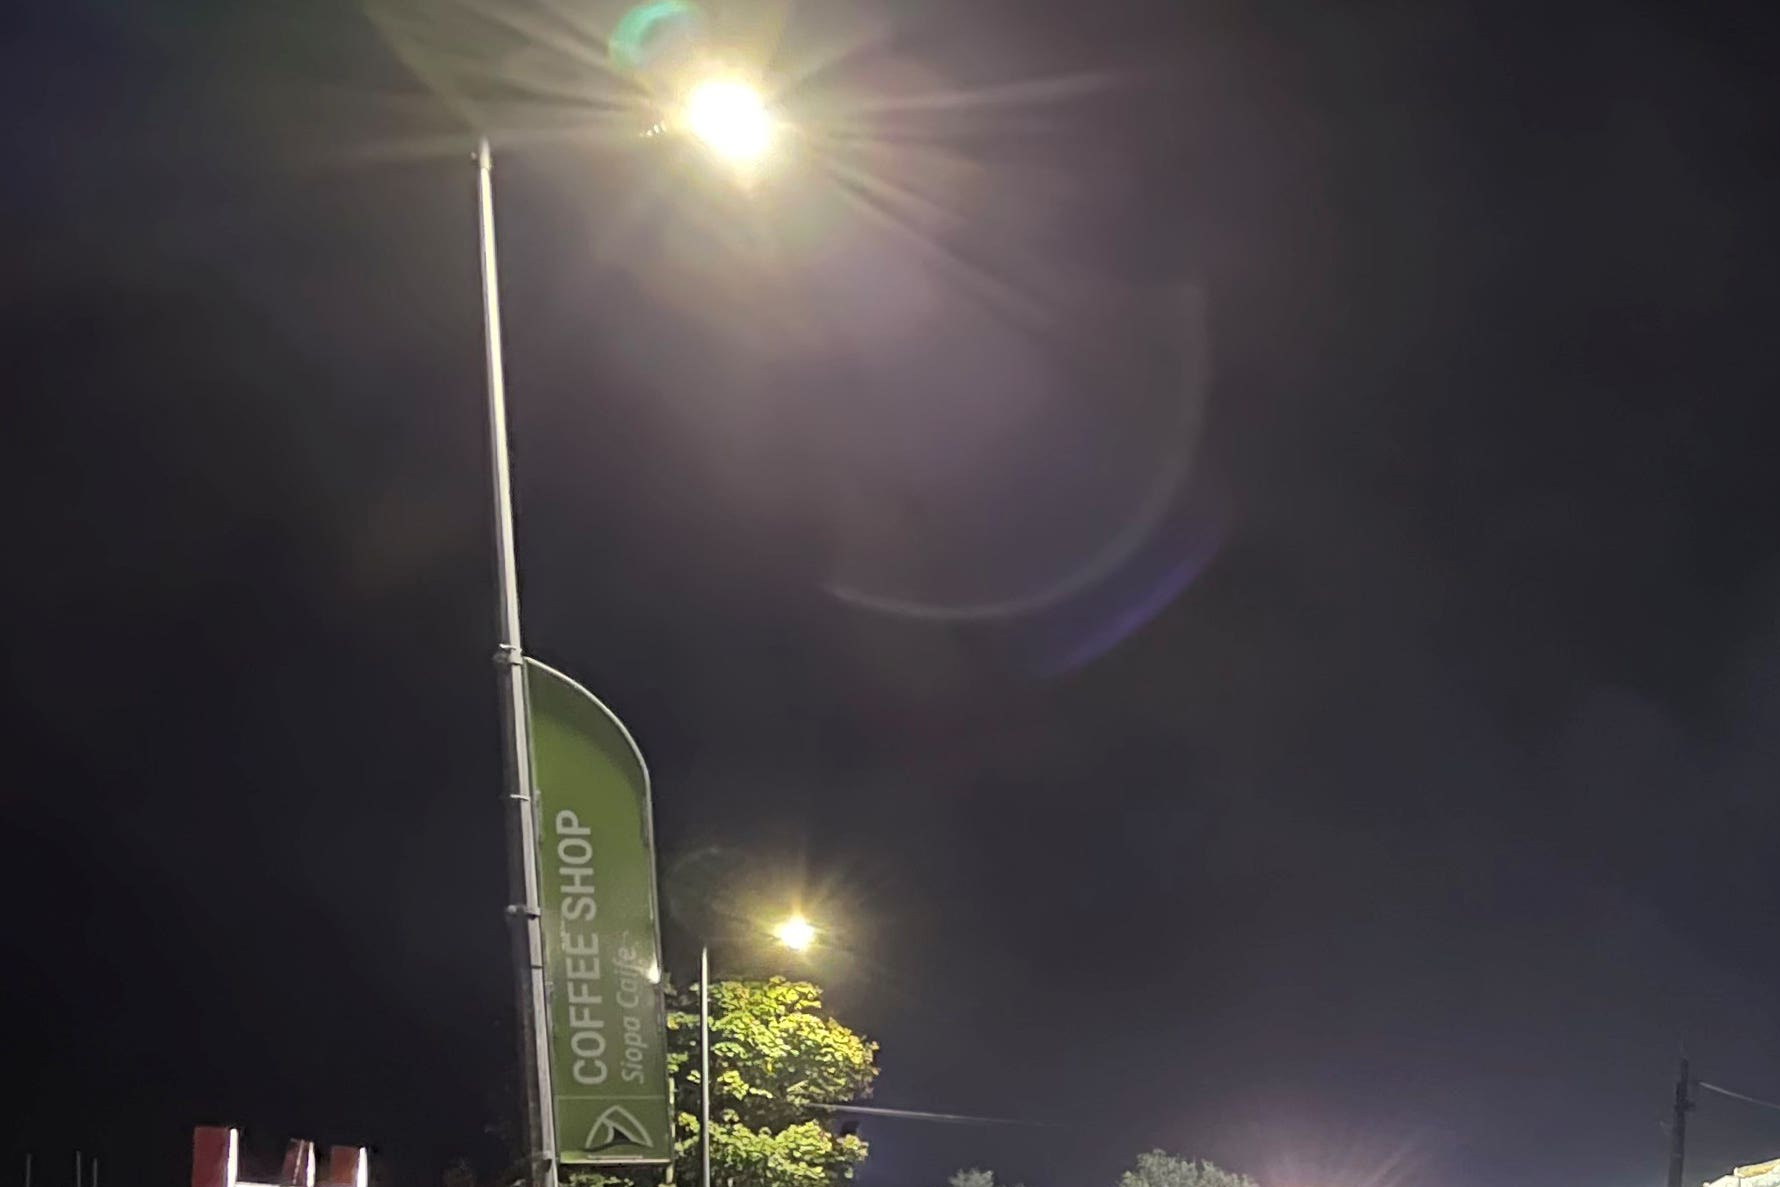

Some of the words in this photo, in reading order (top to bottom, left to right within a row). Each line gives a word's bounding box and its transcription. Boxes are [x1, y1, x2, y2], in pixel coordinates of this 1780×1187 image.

[555, 809, 598, 922] SHOP
[565, 931, 608, 1085] COFFEE
[620, 1015, 650, 1085] Siopa
